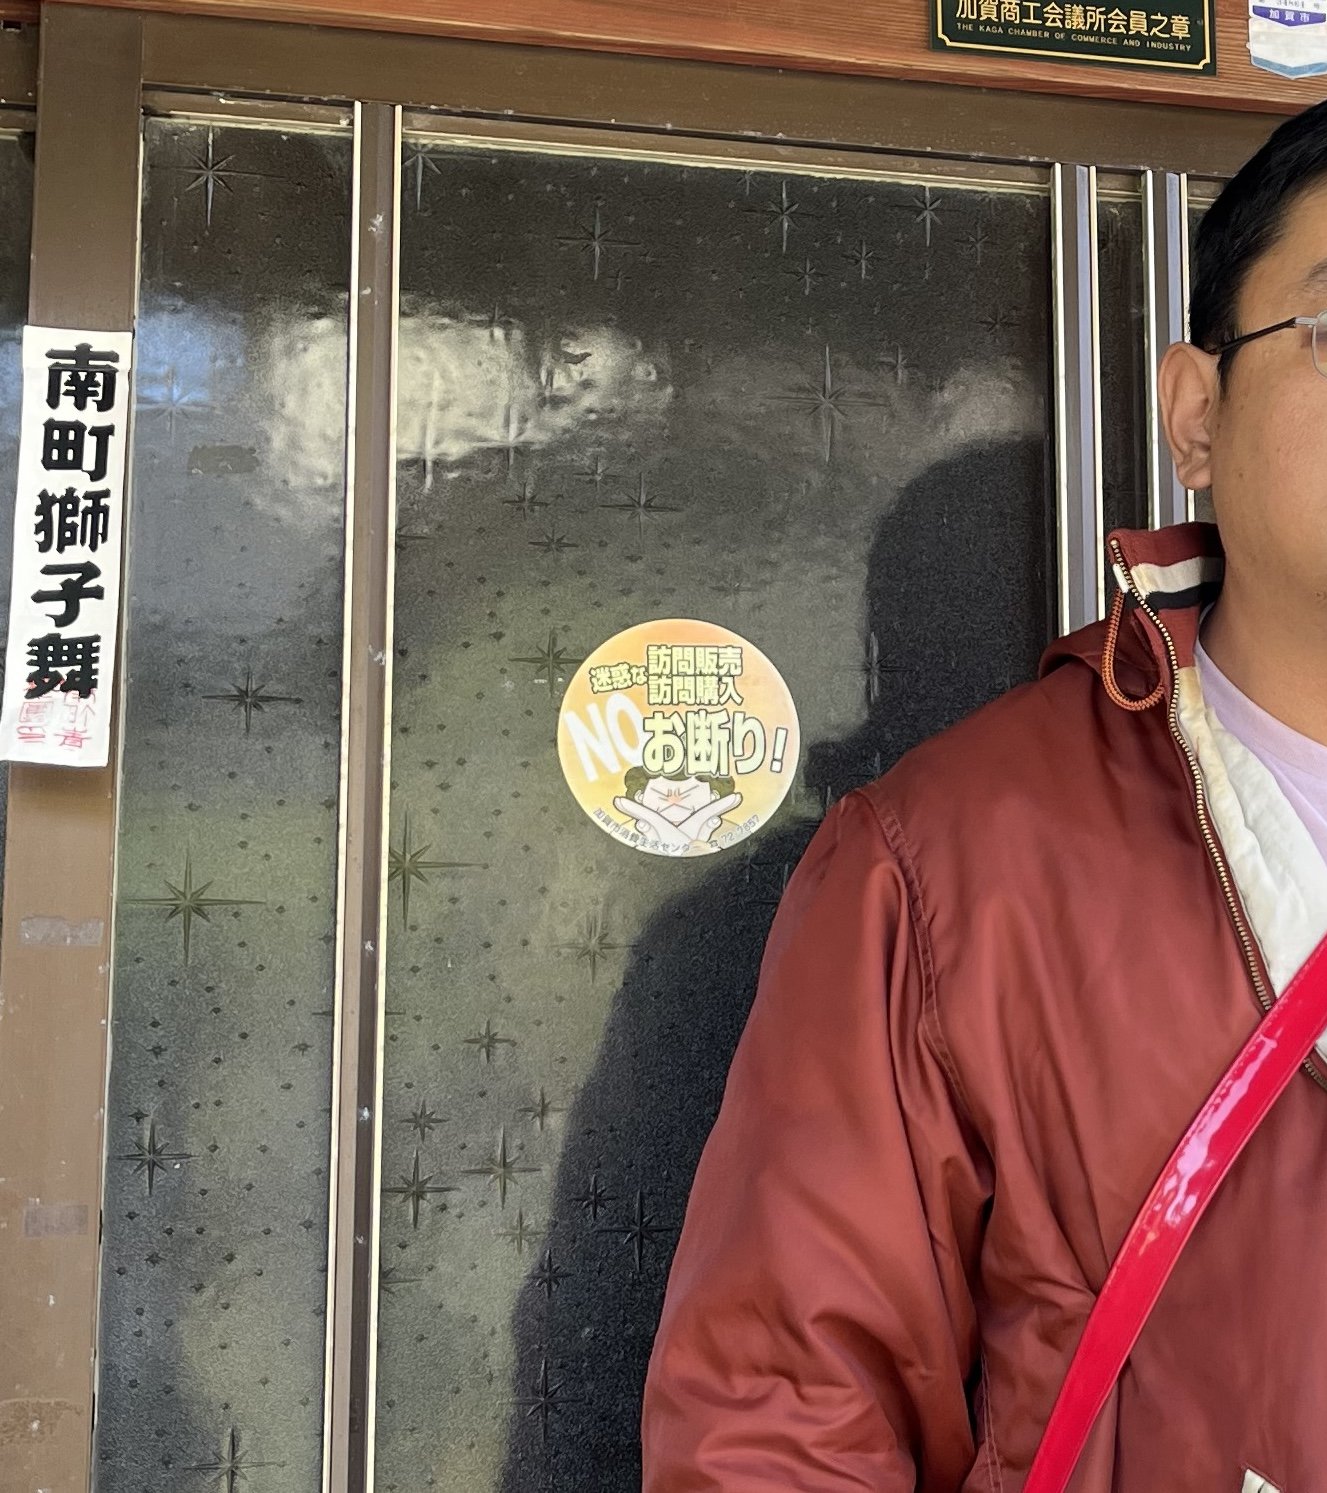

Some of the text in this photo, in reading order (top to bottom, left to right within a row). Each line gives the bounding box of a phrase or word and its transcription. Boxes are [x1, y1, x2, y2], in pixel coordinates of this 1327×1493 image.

[956, 22, 1192, 52] THE KAGA CHAMBER OF COMMERCE AND INDUSTRY
[24, 342, 120, 699] 南町獅子舞
[647, 645, 743, 676] 訪問販売
[589, 661, 648, 694] 迷惑な
[647, 675, 744, 705] 訪問購入
[563, 692, 645, 783] NO
